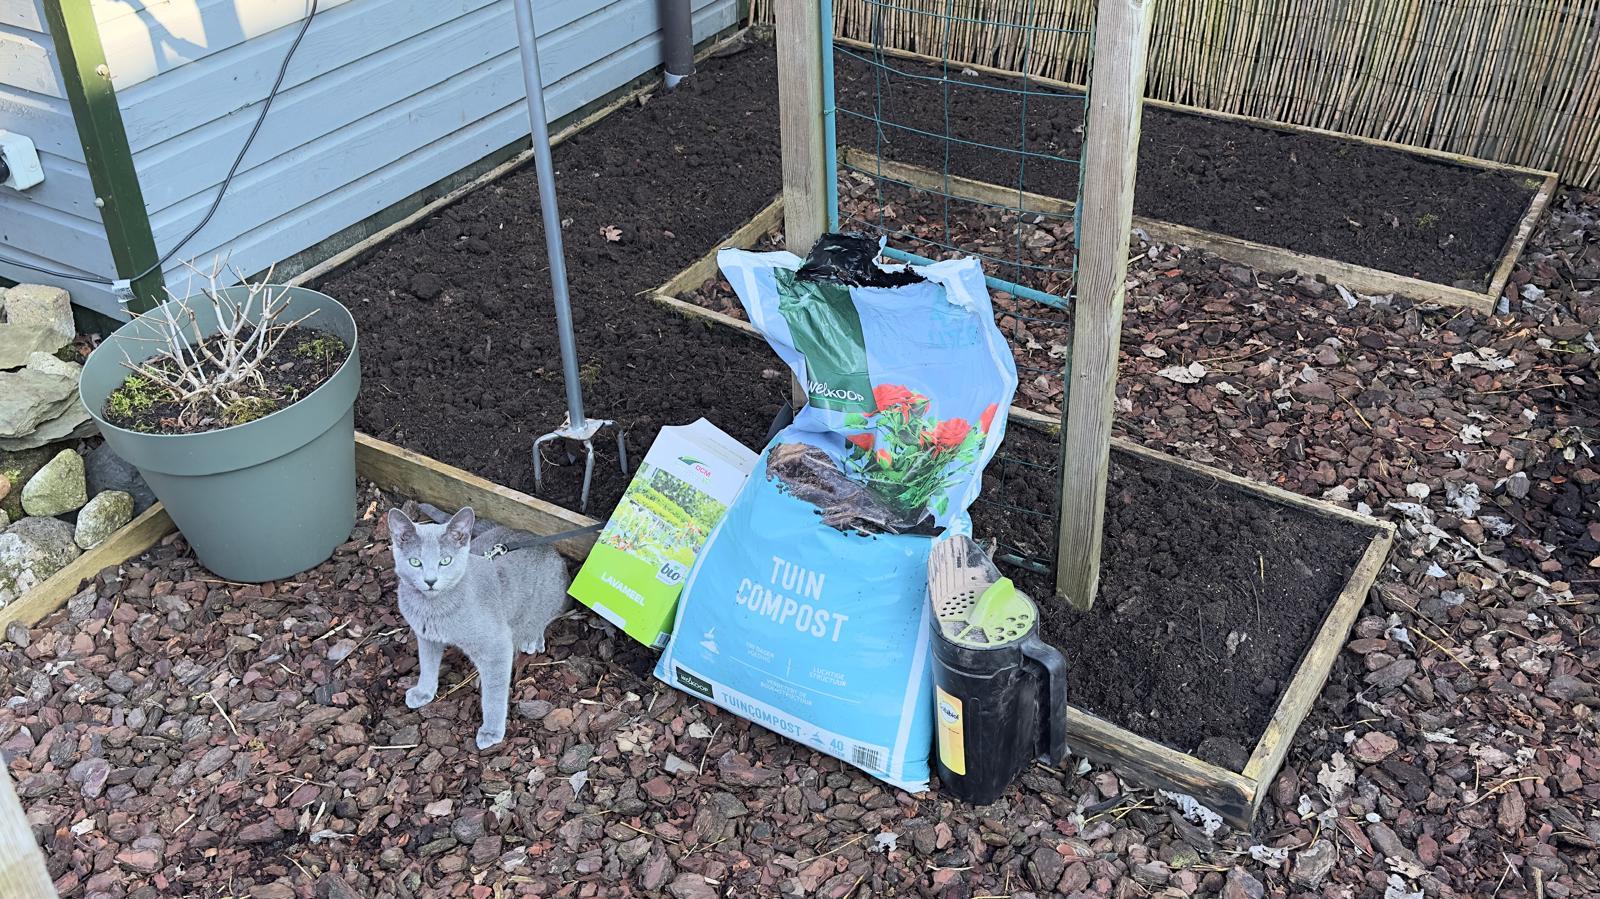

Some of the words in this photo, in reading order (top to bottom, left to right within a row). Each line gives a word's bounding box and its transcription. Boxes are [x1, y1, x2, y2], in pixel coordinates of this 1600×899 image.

[600, 571, 645, 607] LAVAMEEL
[660, 562, 681, 581] bio
[772, 555, 826, 601] TUIN
[736, 578, 849, 642] COMPOST
[720, 692, 802, 737] TUINCOMPOST
[829, 738, 844, 752] 40
